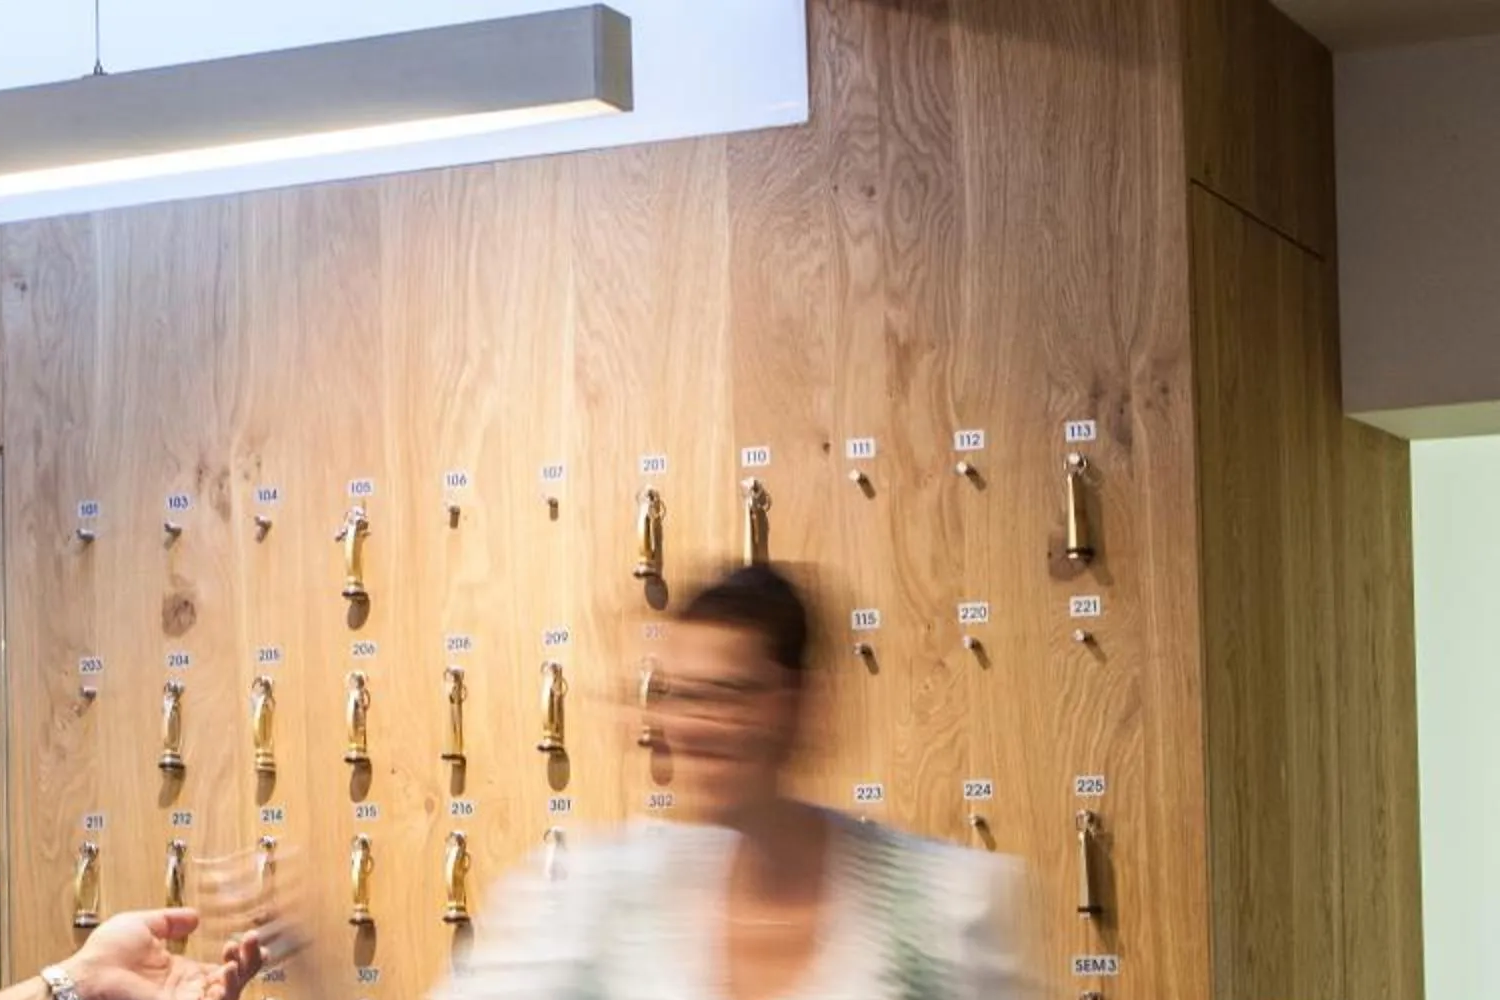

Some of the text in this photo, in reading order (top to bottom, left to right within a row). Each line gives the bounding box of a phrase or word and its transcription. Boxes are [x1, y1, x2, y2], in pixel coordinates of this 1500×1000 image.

[1070, 424, 1092, 439] 113
[959, 433, 981, 449] 112
[852, 441, 871, 457] 111
[746, 450, 768, 465] 110
[960, 606, 988, 621] 220
[1073, 599, 1098, 614] 221
[854, 611, 877, 626] 115
[964, 783, 992, 798] 224
[1076, 778, 1104, 793] 225
[855, 786, 882, 801] 223
